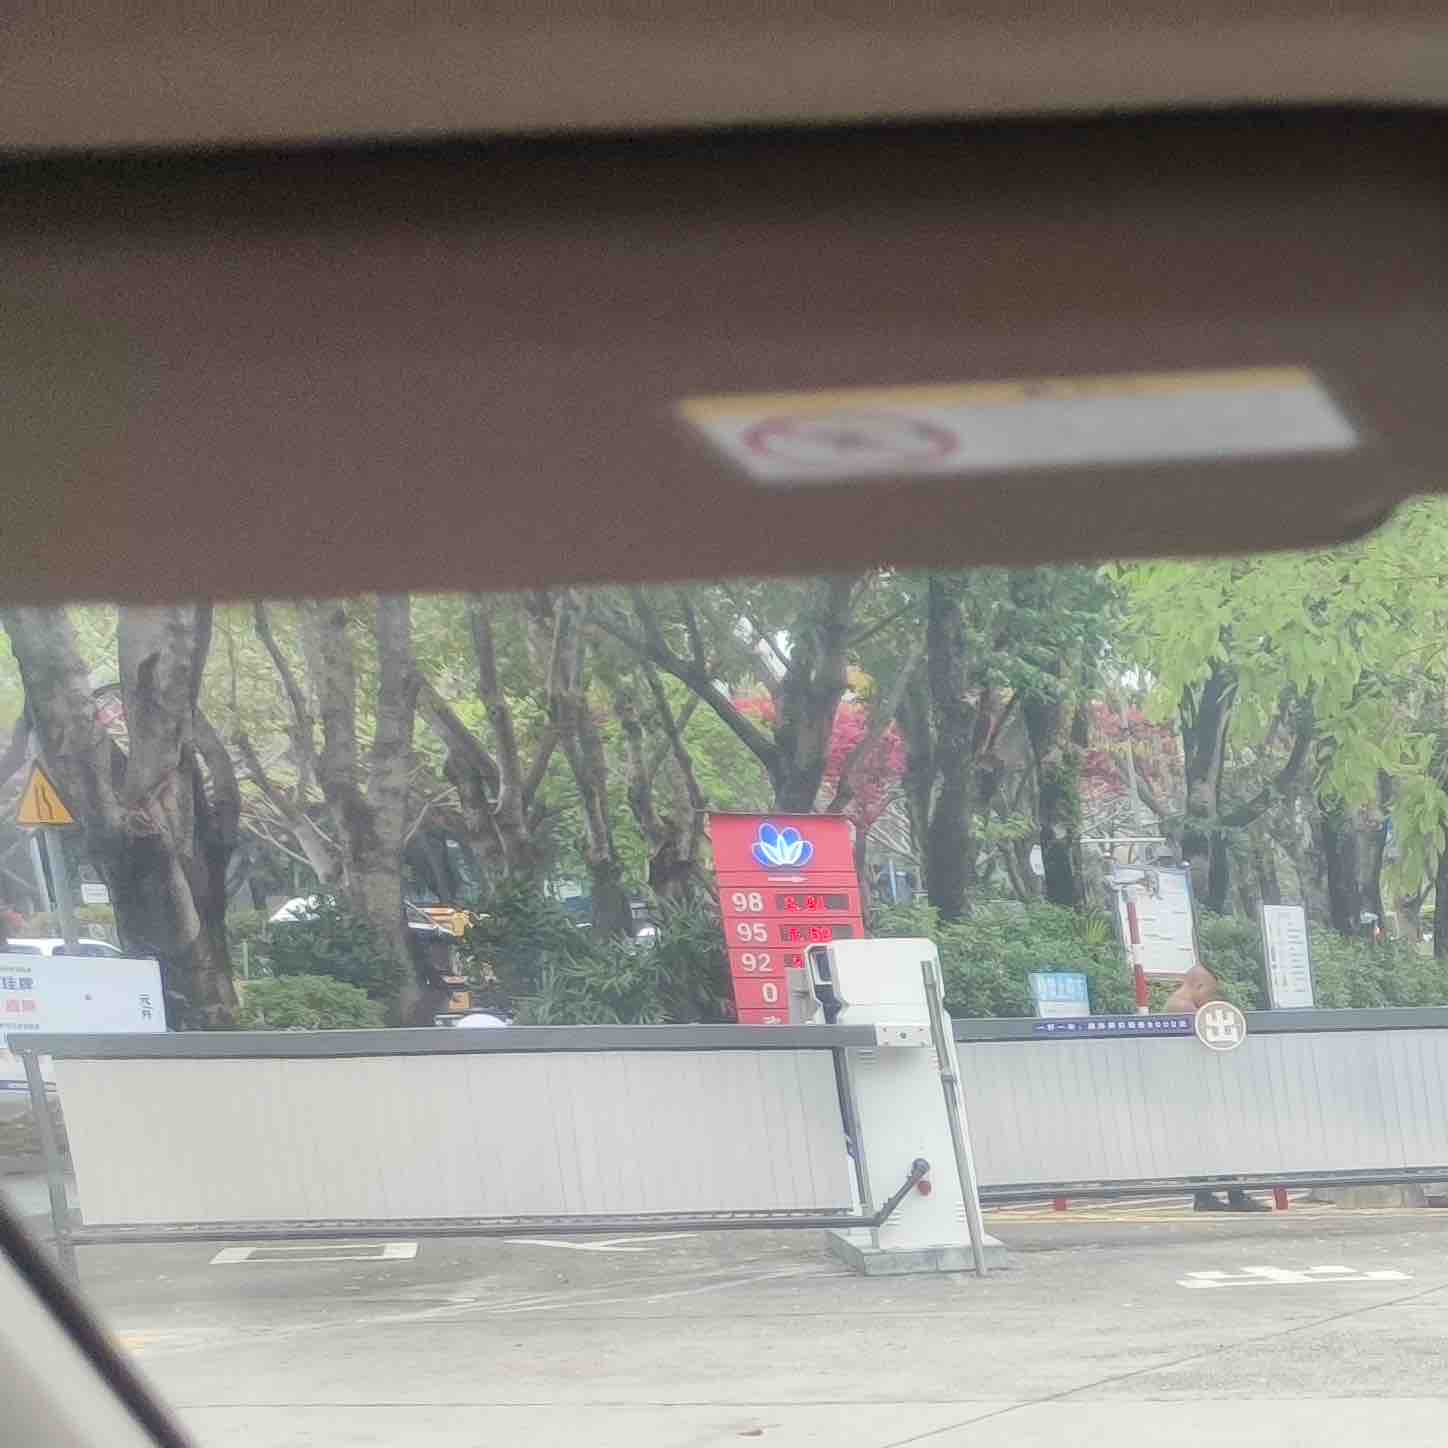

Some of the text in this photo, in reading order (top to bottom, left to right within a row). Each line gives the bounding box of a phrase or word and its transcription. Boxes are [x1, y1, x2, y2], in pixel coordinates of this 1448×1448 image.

[731, 892, 764, 913] 98
[735, 923, 768, 943] 95
[741, 953, 774, 973] 92
